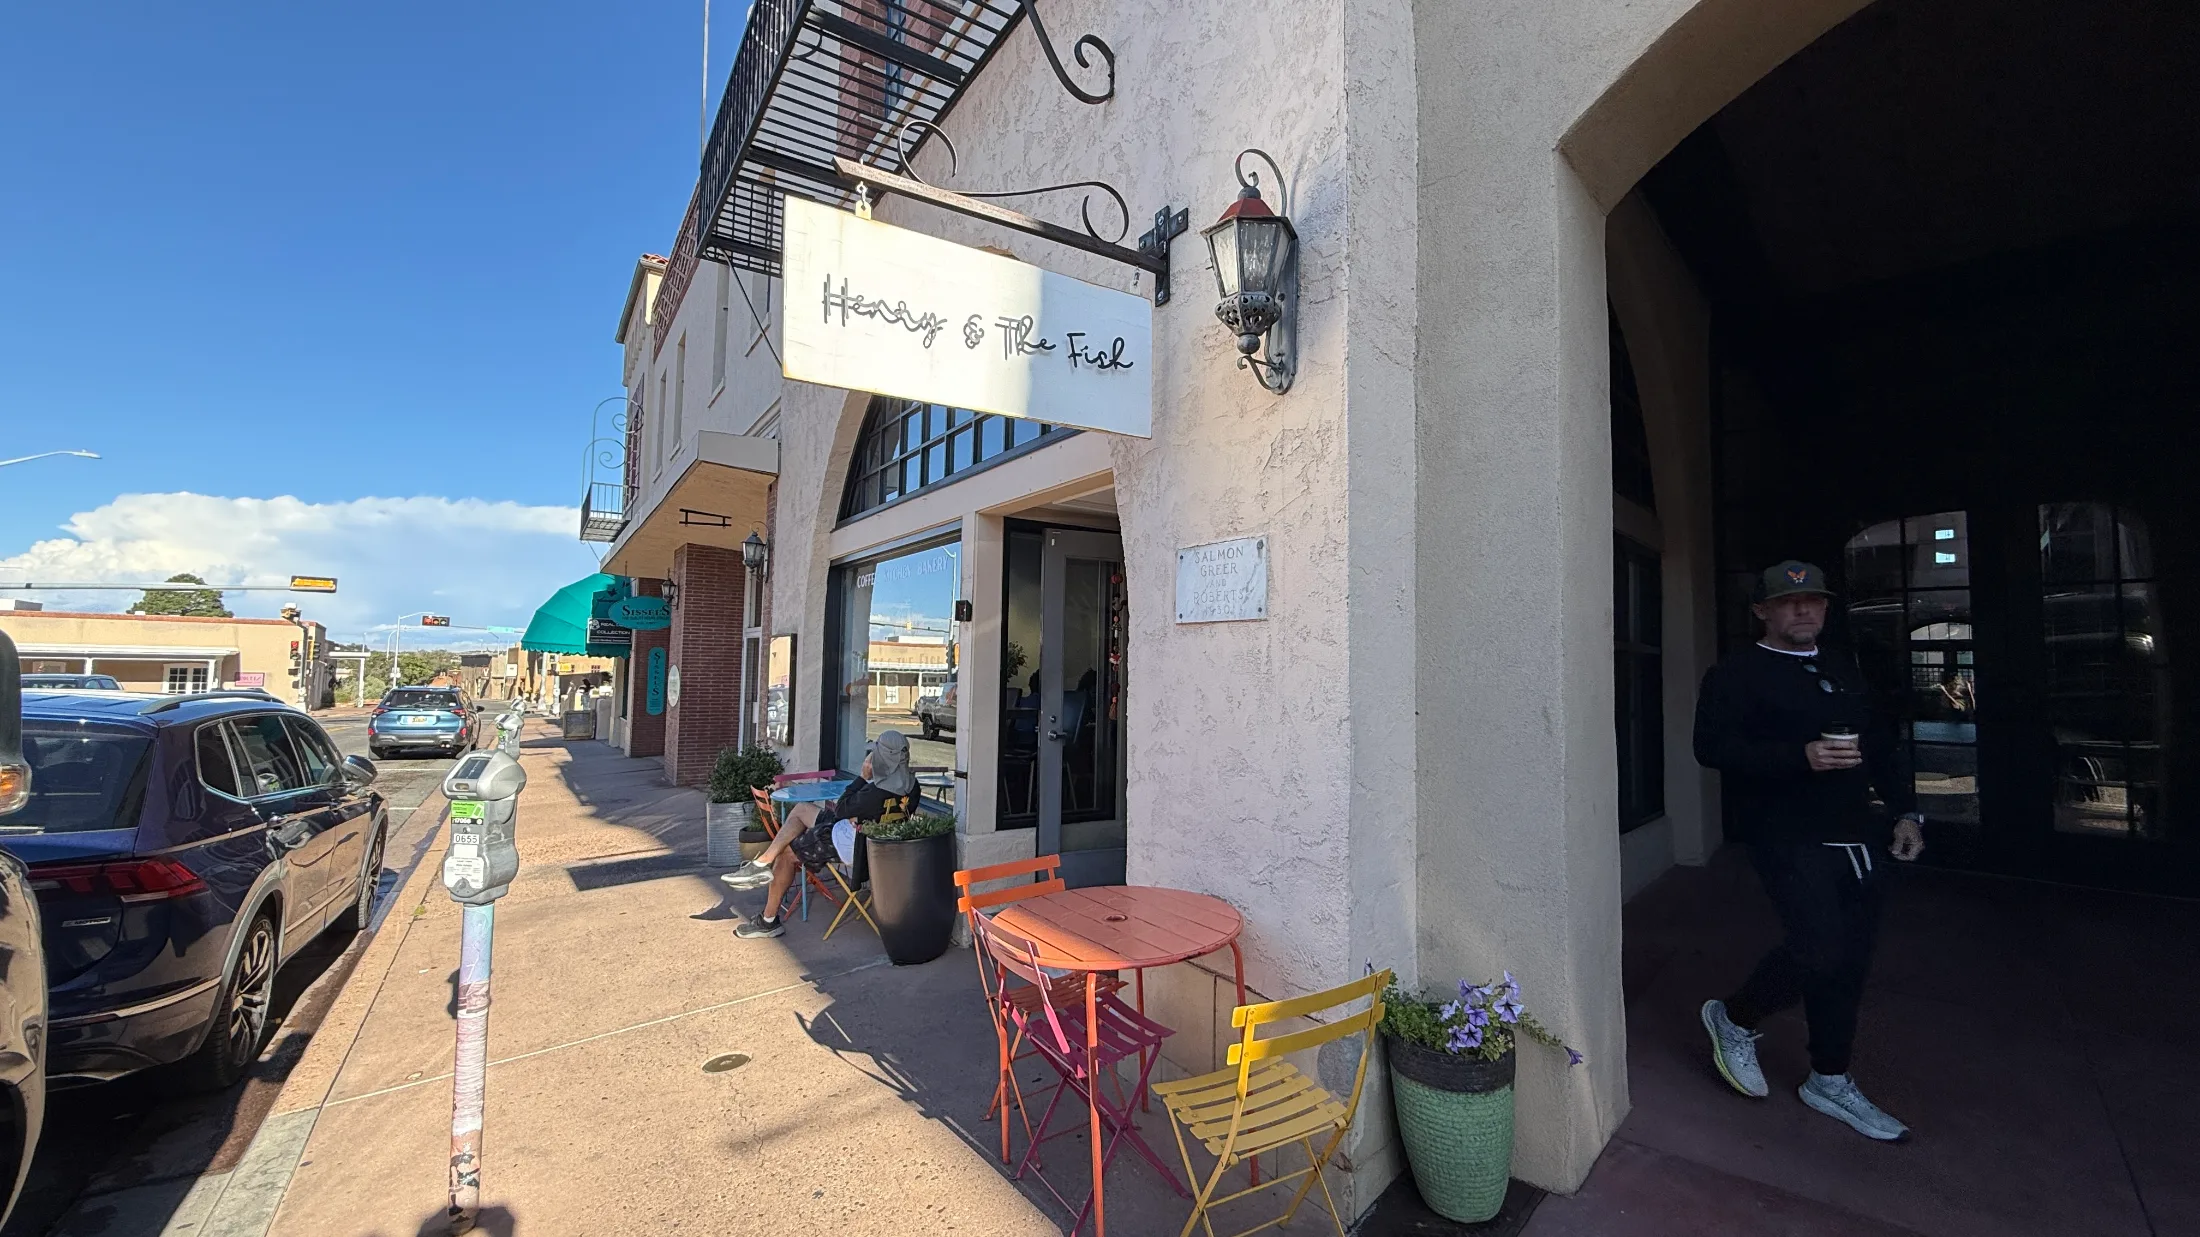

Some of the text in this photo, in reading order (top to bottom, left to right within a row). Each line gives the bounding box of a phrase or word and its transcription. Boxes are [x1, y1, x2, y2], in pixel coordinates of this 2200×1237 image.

[821, 273, 1134, 370] Henry & The Fish
[1194, 546, 1244, 564] SALMON
[857, 572, 877, 588] COFFE
[918, 556, 949, 575] BAKERY
[1200, 562, 1238, 577] GREER
[1193, 588, 1244, 606] ROBERTS
[455, 834, 478, 844] 0655
